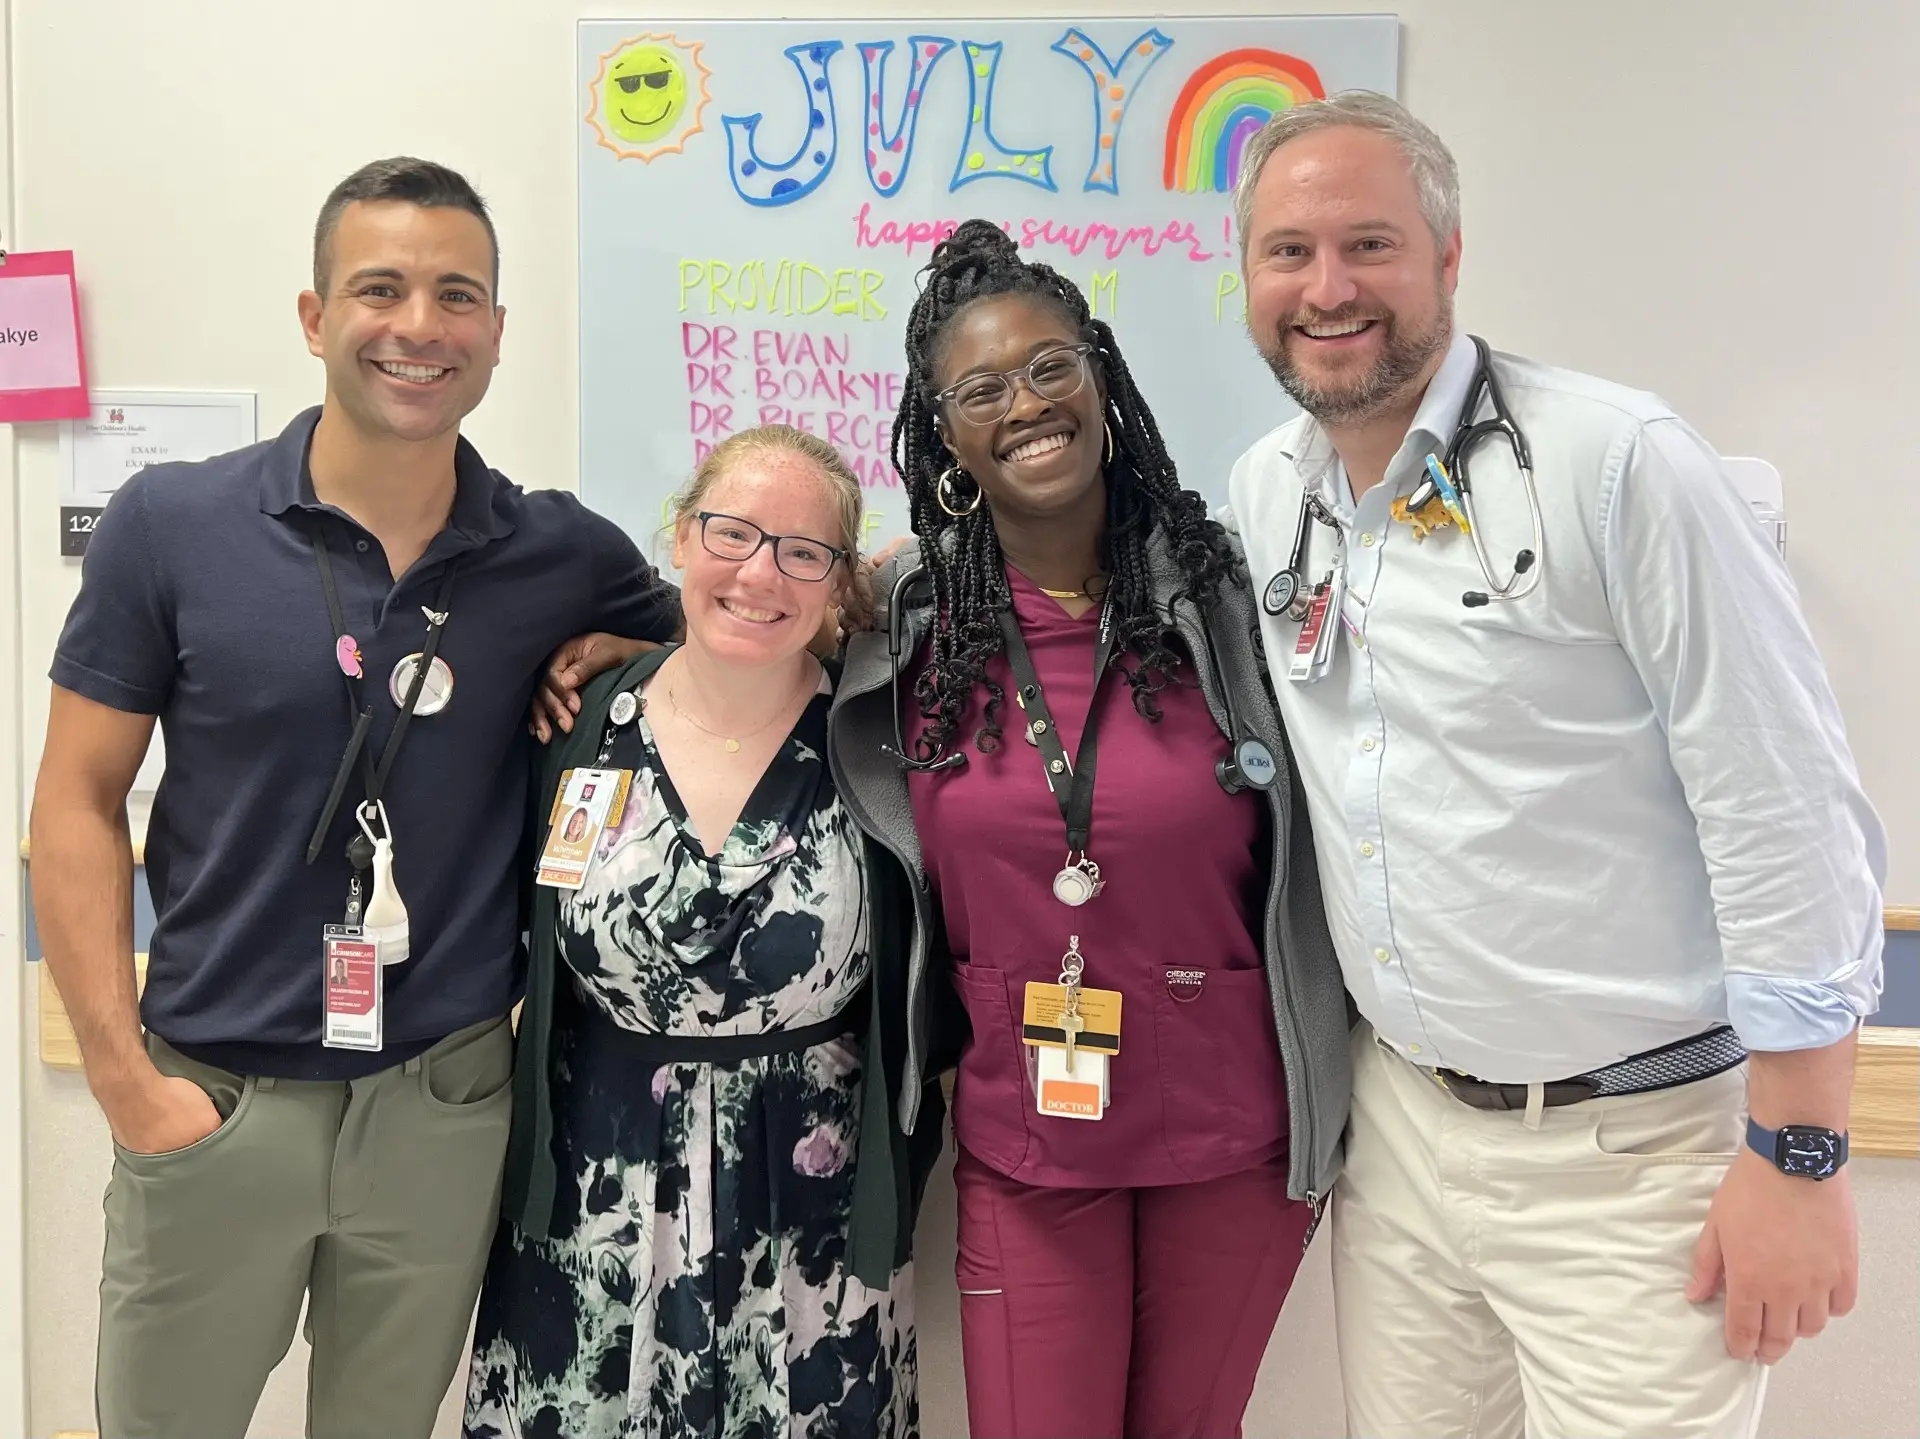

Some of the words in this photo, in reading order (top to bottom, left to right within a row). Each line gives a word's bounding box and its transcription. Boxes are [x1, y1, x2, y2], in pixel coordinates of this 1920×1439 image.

[721, 28, 1175, 207] JULY
[853, 202, 1010, 257] happ
[678, 258, 889, 321] PROVIDER
[682, 321, 749, 361] DR.
[753, 329, 850, 368] EVAN
[687, 362, 747, 399] DR.
[755, 367, 904, 412] BOAKYE
[1047, 1099, 1094, 1113] DOCTOR
